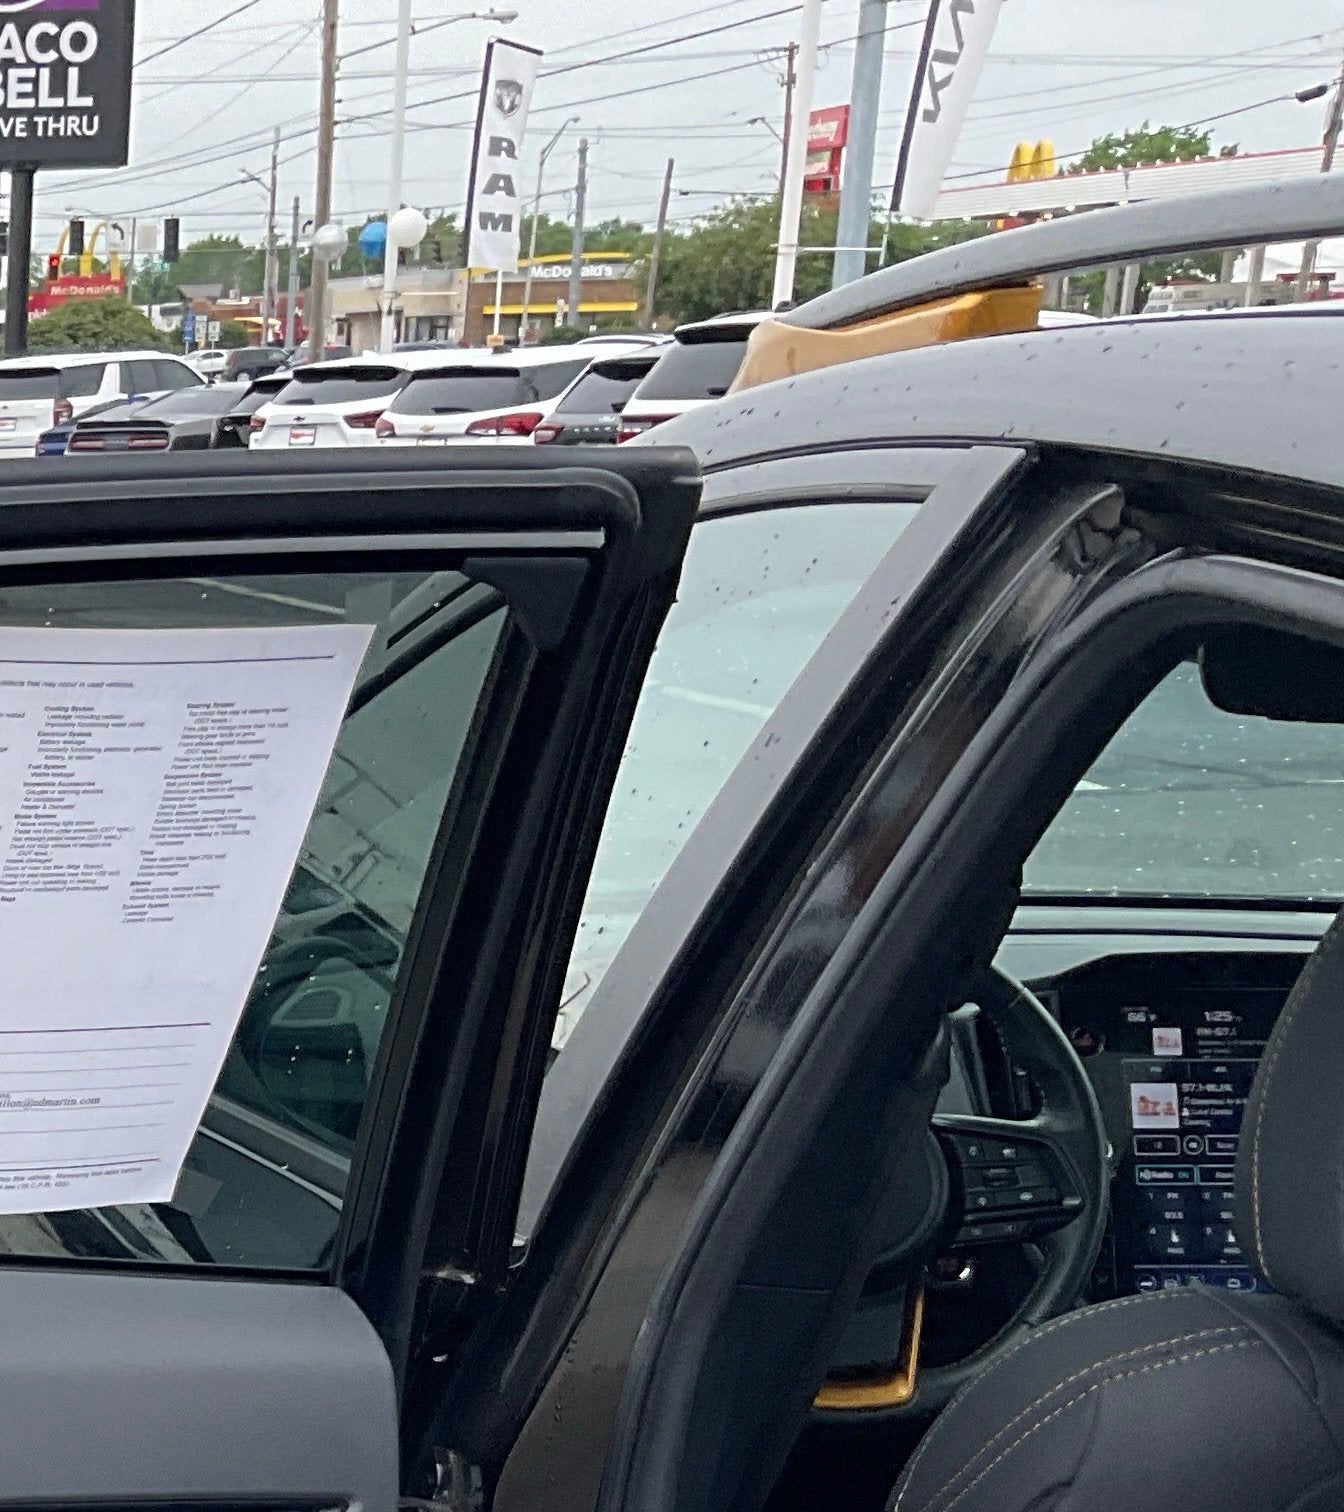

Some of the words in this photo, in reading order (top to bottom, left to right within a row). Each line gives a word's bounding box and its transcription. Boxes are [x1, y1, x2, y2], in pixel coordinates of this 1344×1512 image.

[33, 114, 100, 137] THRU
[478, 136, 518, 234] RAM
[530, 263, 614, 279] McDoald's
